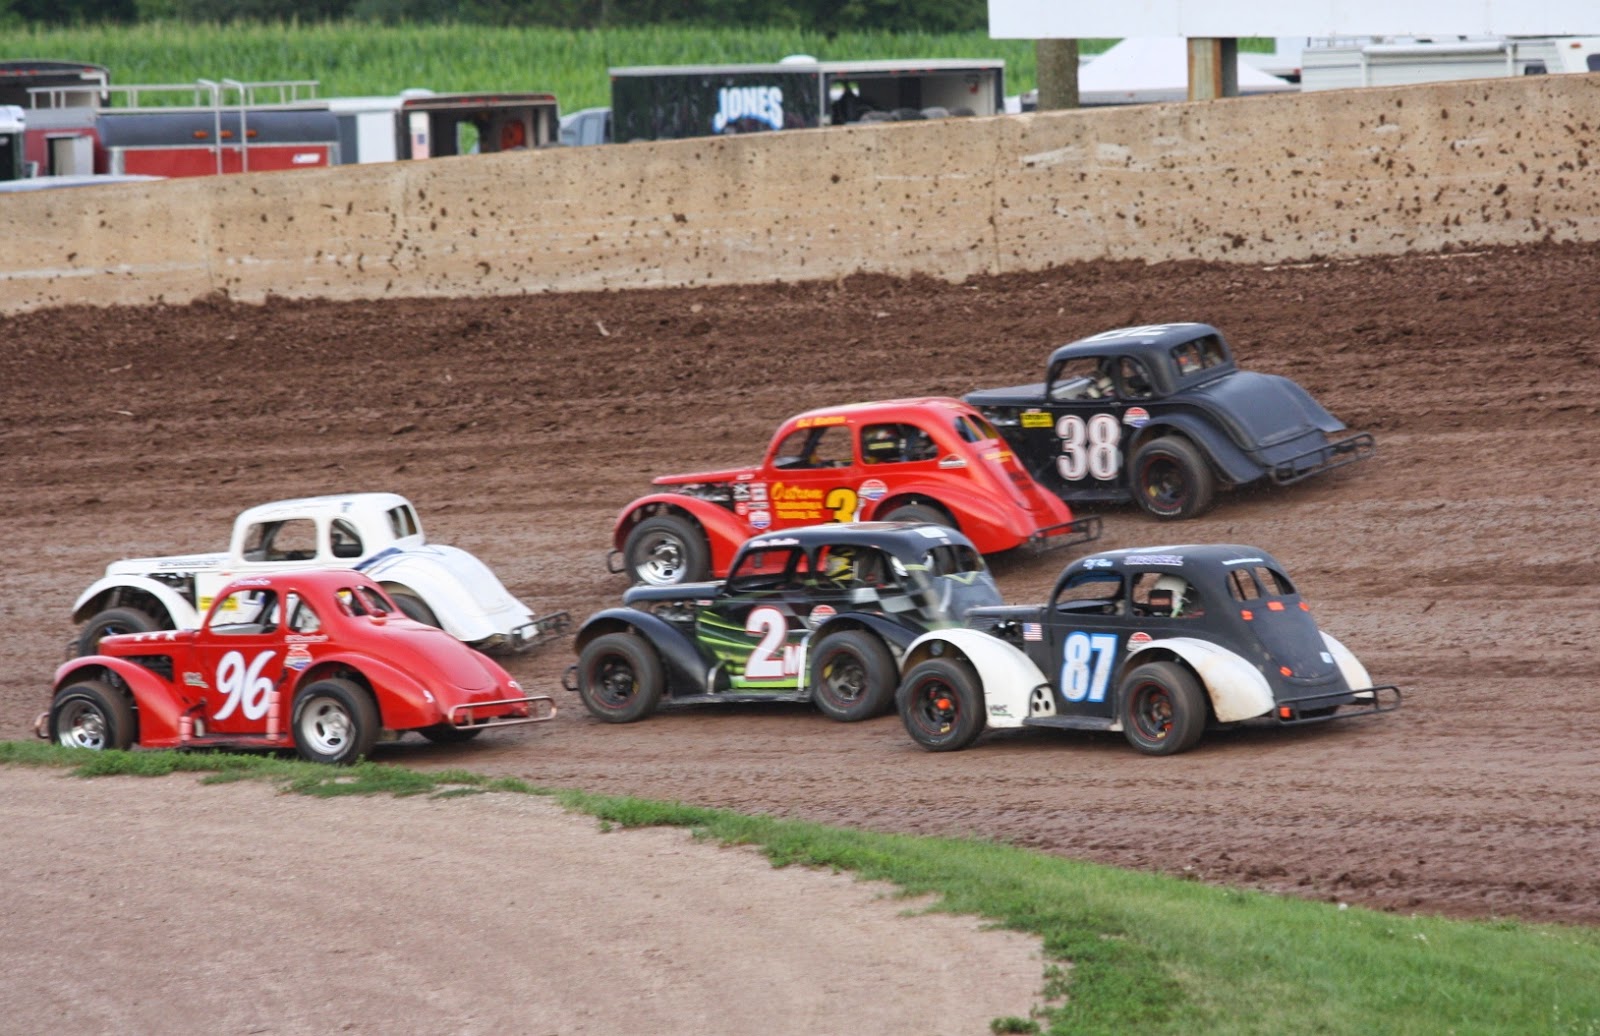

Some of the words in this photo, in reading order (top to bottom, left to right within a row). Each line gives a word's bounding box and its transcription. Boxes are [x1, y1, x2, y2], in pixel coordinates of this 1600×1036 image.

[713, 85, 784, 132] JONES
[1055, 413, 1122, 481] 38
[826, 487, 858, 523] 3
[212, 651, 276, 720] 96
[1061, 631, 1118, 702] 87
